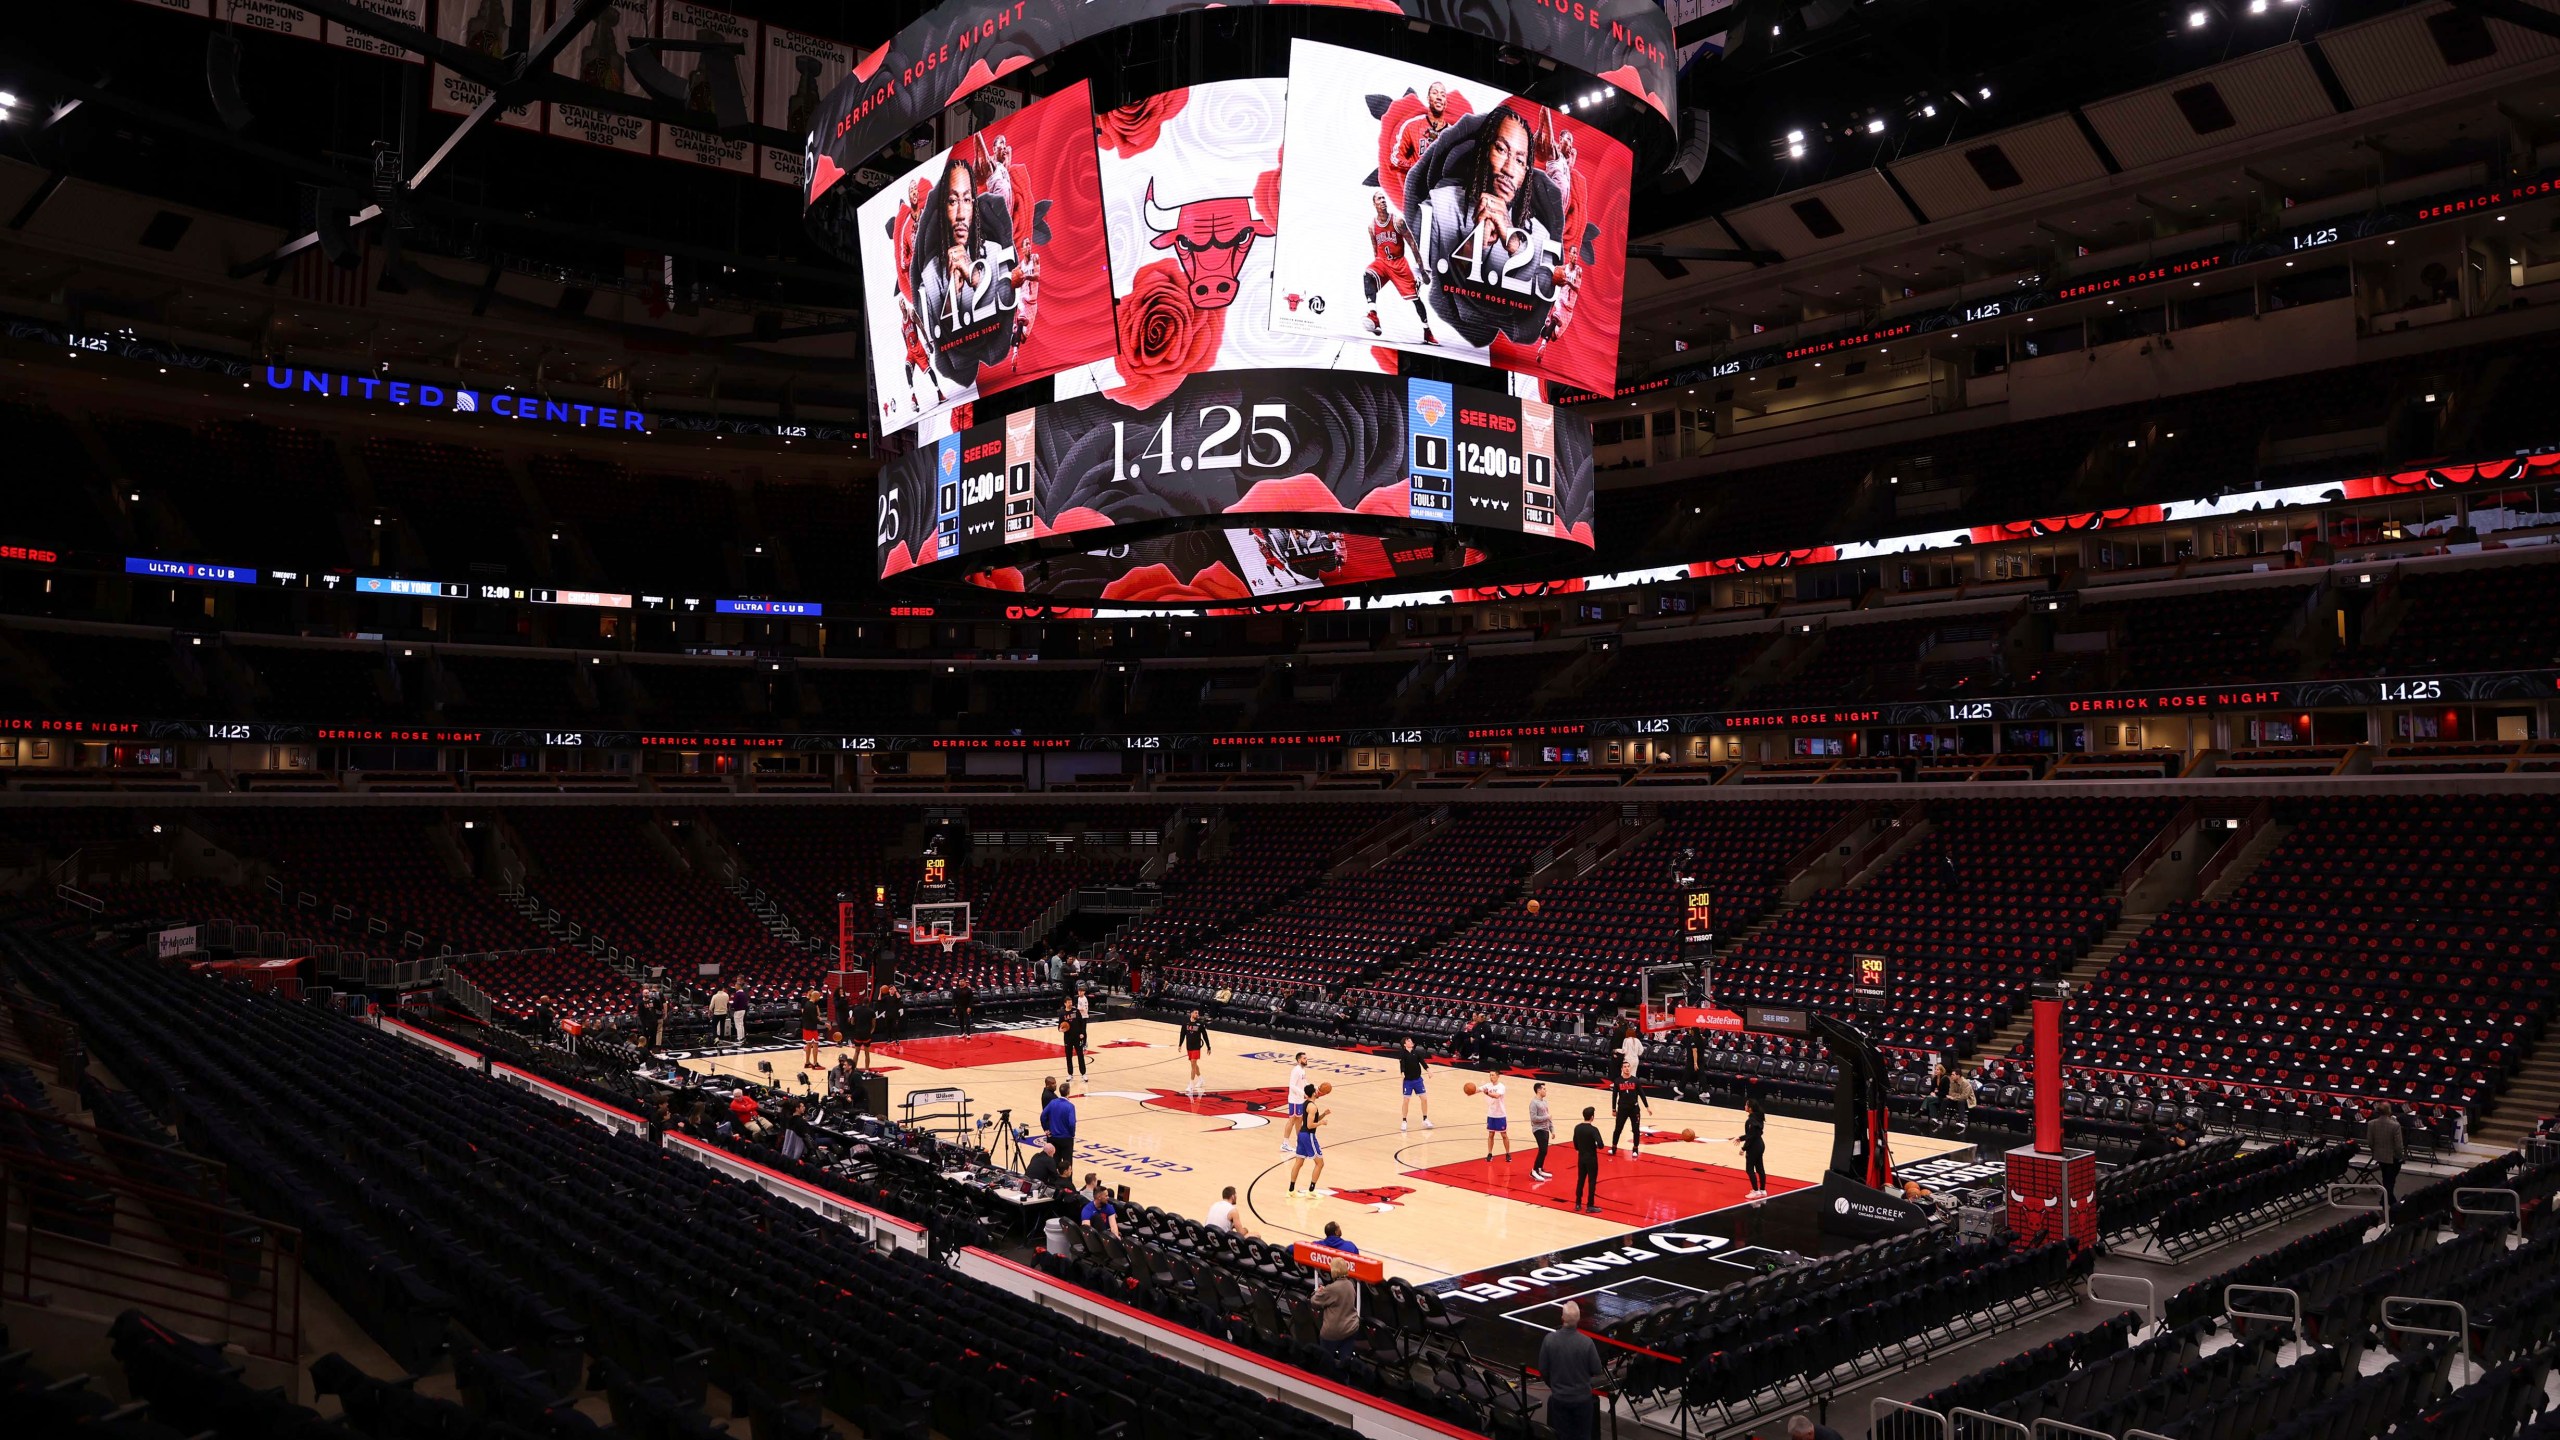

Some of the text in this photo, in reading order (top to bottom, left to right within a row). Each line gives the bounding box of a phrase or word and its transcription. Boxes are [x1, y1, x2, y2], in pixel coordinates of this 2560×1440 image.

[235, 0, 304, 22] CHAMPIONS
[685, 5, 737, 25] CHICAGO
[246, 14, 293, 33] 2012-13
[671, 11, 750, 39] BLACKHAWKS
[345, 36, 407, 58] 2016-2017
[785, 31, 834, 51] CHICAGO
[1611, 20, 1667, 71] NIGHT
[773, 37, 846, 64] BLACKHAWKS
[836, 0, 1026, 140] DERRICK ROSE NIGHT
[558, 104, 643, 131] STANLEY CUP
[564, 115, 638, 141] CHAMPIONS
[585, 131, 615, 146] 1938
[721, 139, 748, 152] CUP
[674, 138, 743, 161] CHAMPIONS
[696, 153, 722, 167] 1961
[2419, 179, 2560, 219] DERRICK ROSE
[2294, 228, 2337, 249] 1.4.25
[1416, 203, 1560, 303] 1.4.25
[2060, 256, 2219, 298] DERRICK ROSE NIGHT
[918, 245, 1020, 343] 1.4.25
[1443, 284, 1534, 313] DERRICK ROSE NIGHT
[1967, 303, 2000, 321] 1.4.25
[69, 334, 107, 351] 1.4.25
[940, 322, 1001, 353] DERRICK ROSE NIGHT
[1786, 325, 1910, 358] DERRICK ROSE NIGHT
[1713, 362, 1739, 376] 1.4.25
[1639, 379, 1668, 390] NIGHT
[267, 366, 644, 432] UNITED CENTER
[1459, 408, 1518, 434] SEE RED
[778, 426, 806, 436] 1.4.25
[963, 439, 1003, 465] SEE RED
[1110, 403, 1293, 484] 1.4.25
[1426, 439, 1437, 466] 0
[1457, 440, 1508, 479] 12:00
[1016, 466, 1024, 492] 0
[1535, 458, 1544, 484] 0
[961, 471, 994, 508] 12:00
[1413, 475, 1448, 492] TO 7
[945, 486, 952, 511] 0
[1025, 500, 1031, 513] 7
[1413, 492, 1448, 510] FOULS 0
[1526, 491, 1552, 508] TO 7
[1526, 508, 1544, 523] FOULS
[1007, 519, 1023, 532] FOULS
[0, 546, 56, 562] SEE RED
[1393, 549, 1415, 561] SEE
[149, 562, 236, 580] ULTRA CLUB
[272, 570, 297, 580] TIMEOUTS
[323, 574, 340, 584] FOULS
[391, 580, 432, 595] NEW YORK
[450, 584, 458, 597] 0
[482, 586, 509, 598] 12:00
[541, 590, 548, 602] 0
[685, 598, 700, 606] FOULS
[734, 602, 804, 614] ULTRA CLUB
[890, 606, 935, 617] SEE RED
[2381, 681, 2440, 700] 1.4.25
[2070, 692, 2279, 711] DERRICK ROSE NIGHT
[1726, 711, 1879, 726] DERRICK ROSE NIGHT
[1950, 704, 1992, 719] 1.4.25
[42, 721, 138, 732] ROSE NIGHT
[210, 725, 249, 738] 1.4.25
[1469, 725, 1584, 738] DERRICK ROSE NIGHT
[1638, 719, 1669, 732] 1.4.25
[319, 730, 480, 741] DERRICK ROSE NIGHT
[547, 733, 581, 745] 1.4.25
[843, 738, 875, 748] 1.4.25
[1128, 737, 1159, 748] 1.4.25
[1213, 737, 1263, 745] DERRICK
[1392, 731, 1421, 742] 1.4.25
[926, 859, 945, 868] 12:00
[925, 867, 943, 883] 24
[1688, 893, 1709, 906] 12:00
[1687, 906, 1709, 931] 24
[168, 934, 195, 949] Advocate
[1693, 933, 1713, 943] TISSOT
[1862, 959, 1883, 972] 12:00
[1862, 971, 1880, 985] 24
[1863, 988, 1885, 997] TISSOT
[1762, 1014, 1790, 1024] SEE RED
[1083, 1143, 1194, 1173] CENTER
[1850, 1202, 1904, 1219] WIND CREEK
[1438, 1247, 1660, 1303] FANDUEL
